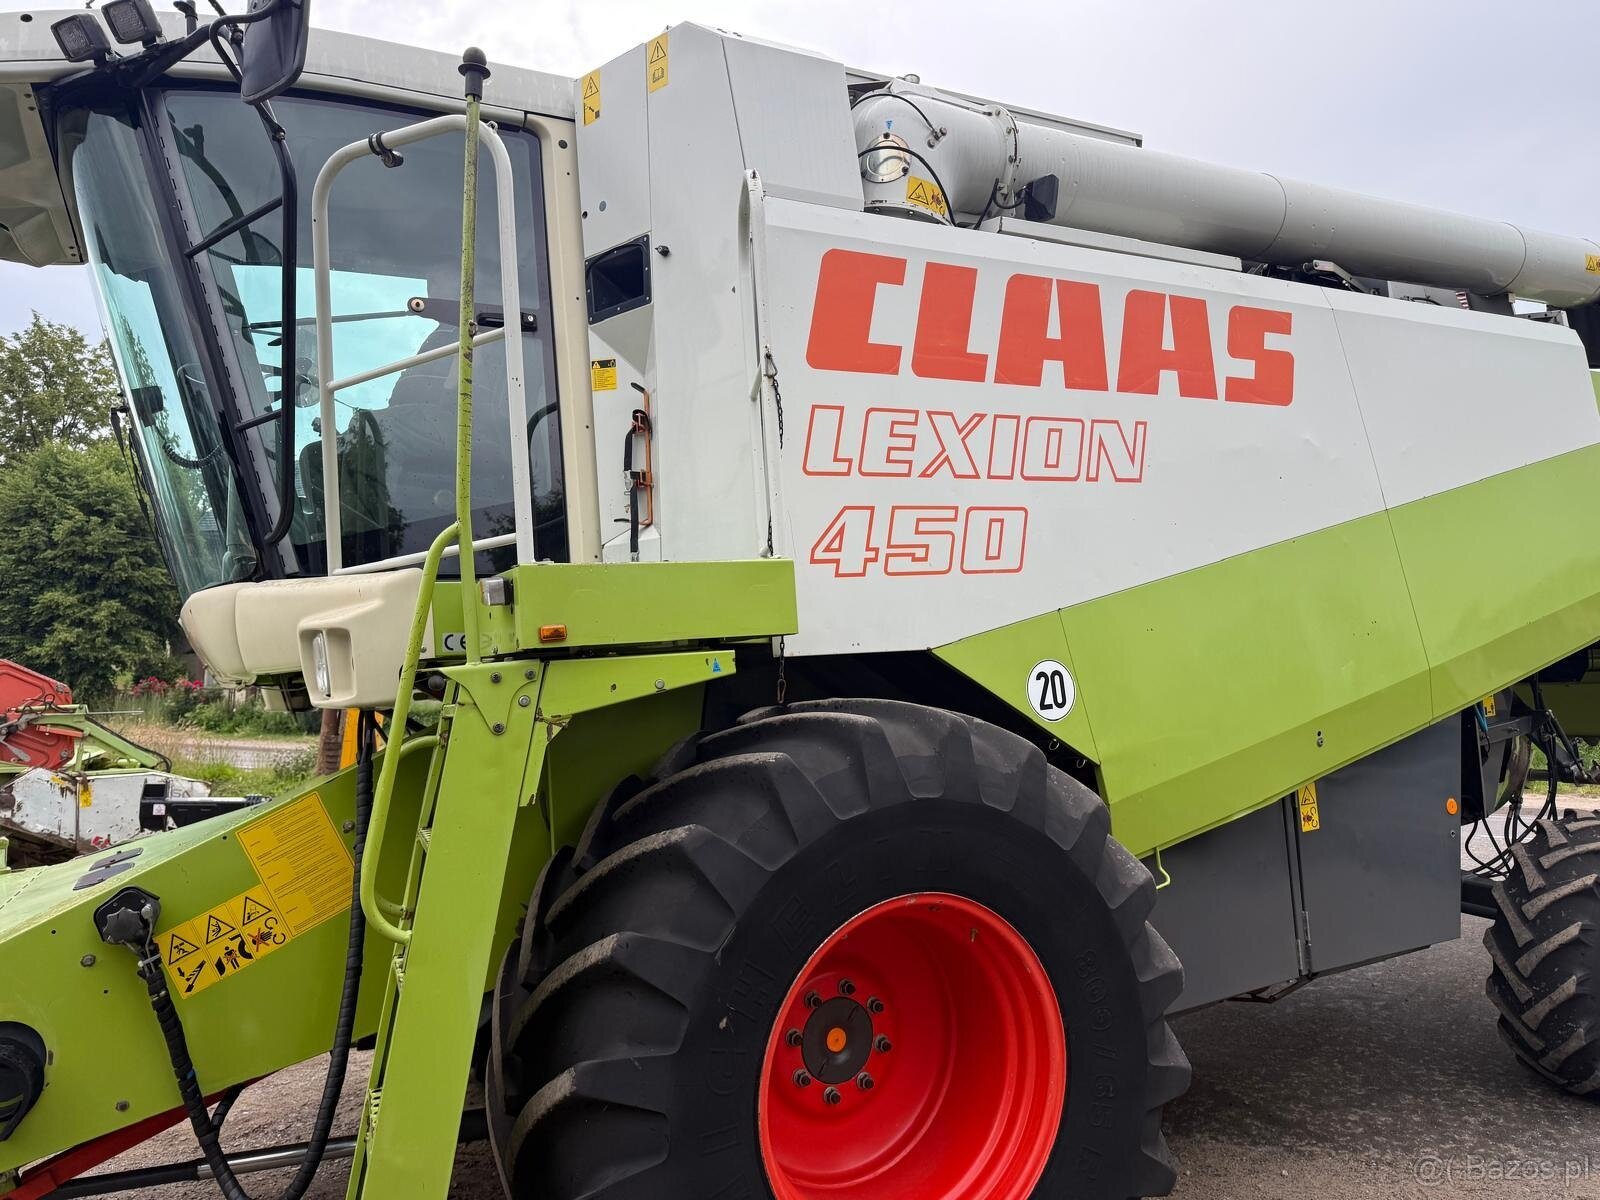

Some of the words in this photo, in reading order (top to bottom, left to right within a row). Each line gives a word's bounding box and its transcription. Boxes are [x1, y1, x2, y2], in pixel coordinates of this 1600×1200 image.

[806, 248, 1295, 407] CLAAS
[802, 404, 1147, 483] LEXION
[809, 506, 1028, 577] 450
[1036, 670, 1067, 711] 20
